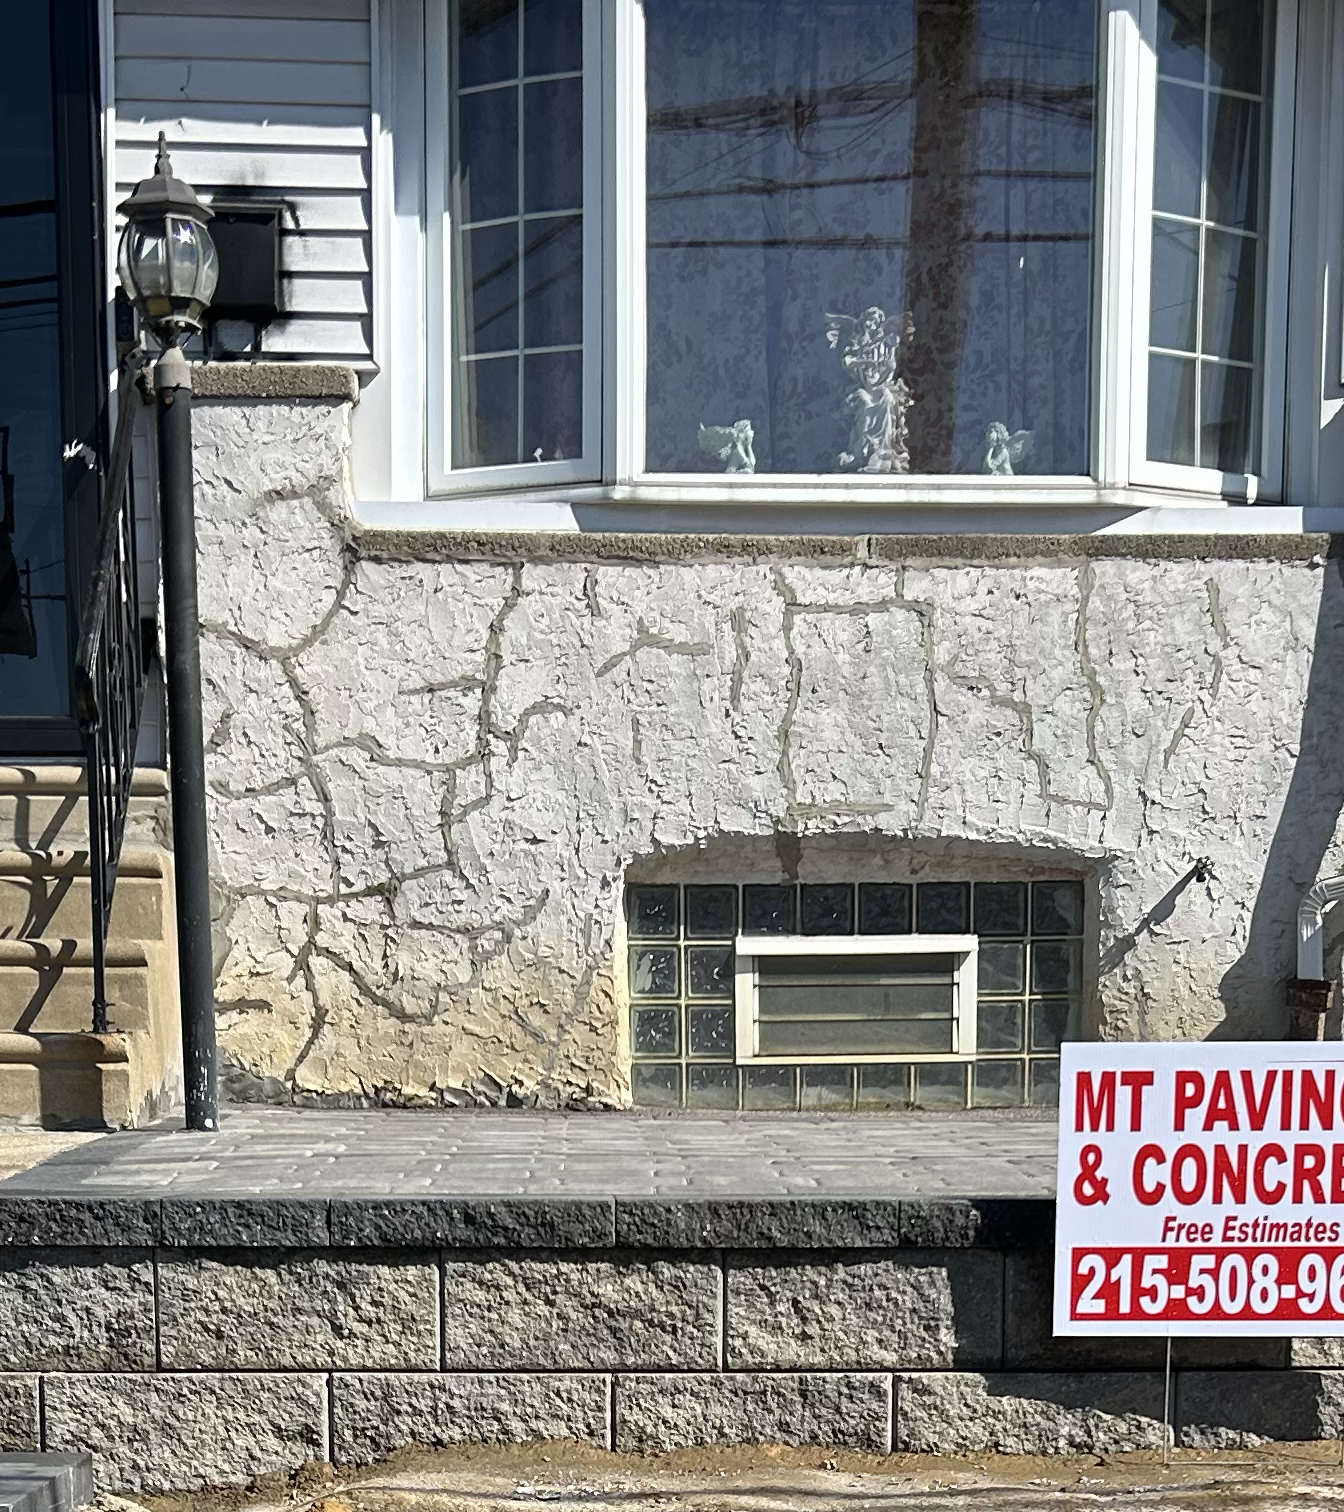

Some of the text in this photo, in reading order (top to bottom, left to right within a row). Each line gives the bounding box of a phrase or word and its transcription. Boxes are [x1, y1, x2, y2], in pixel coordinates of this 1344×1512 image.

[1074, 1070, 1154, 1133] MT
[1072, 1143, 1112, 1206] &
[1161, 1215, 1341, 1243] Free Estimates
